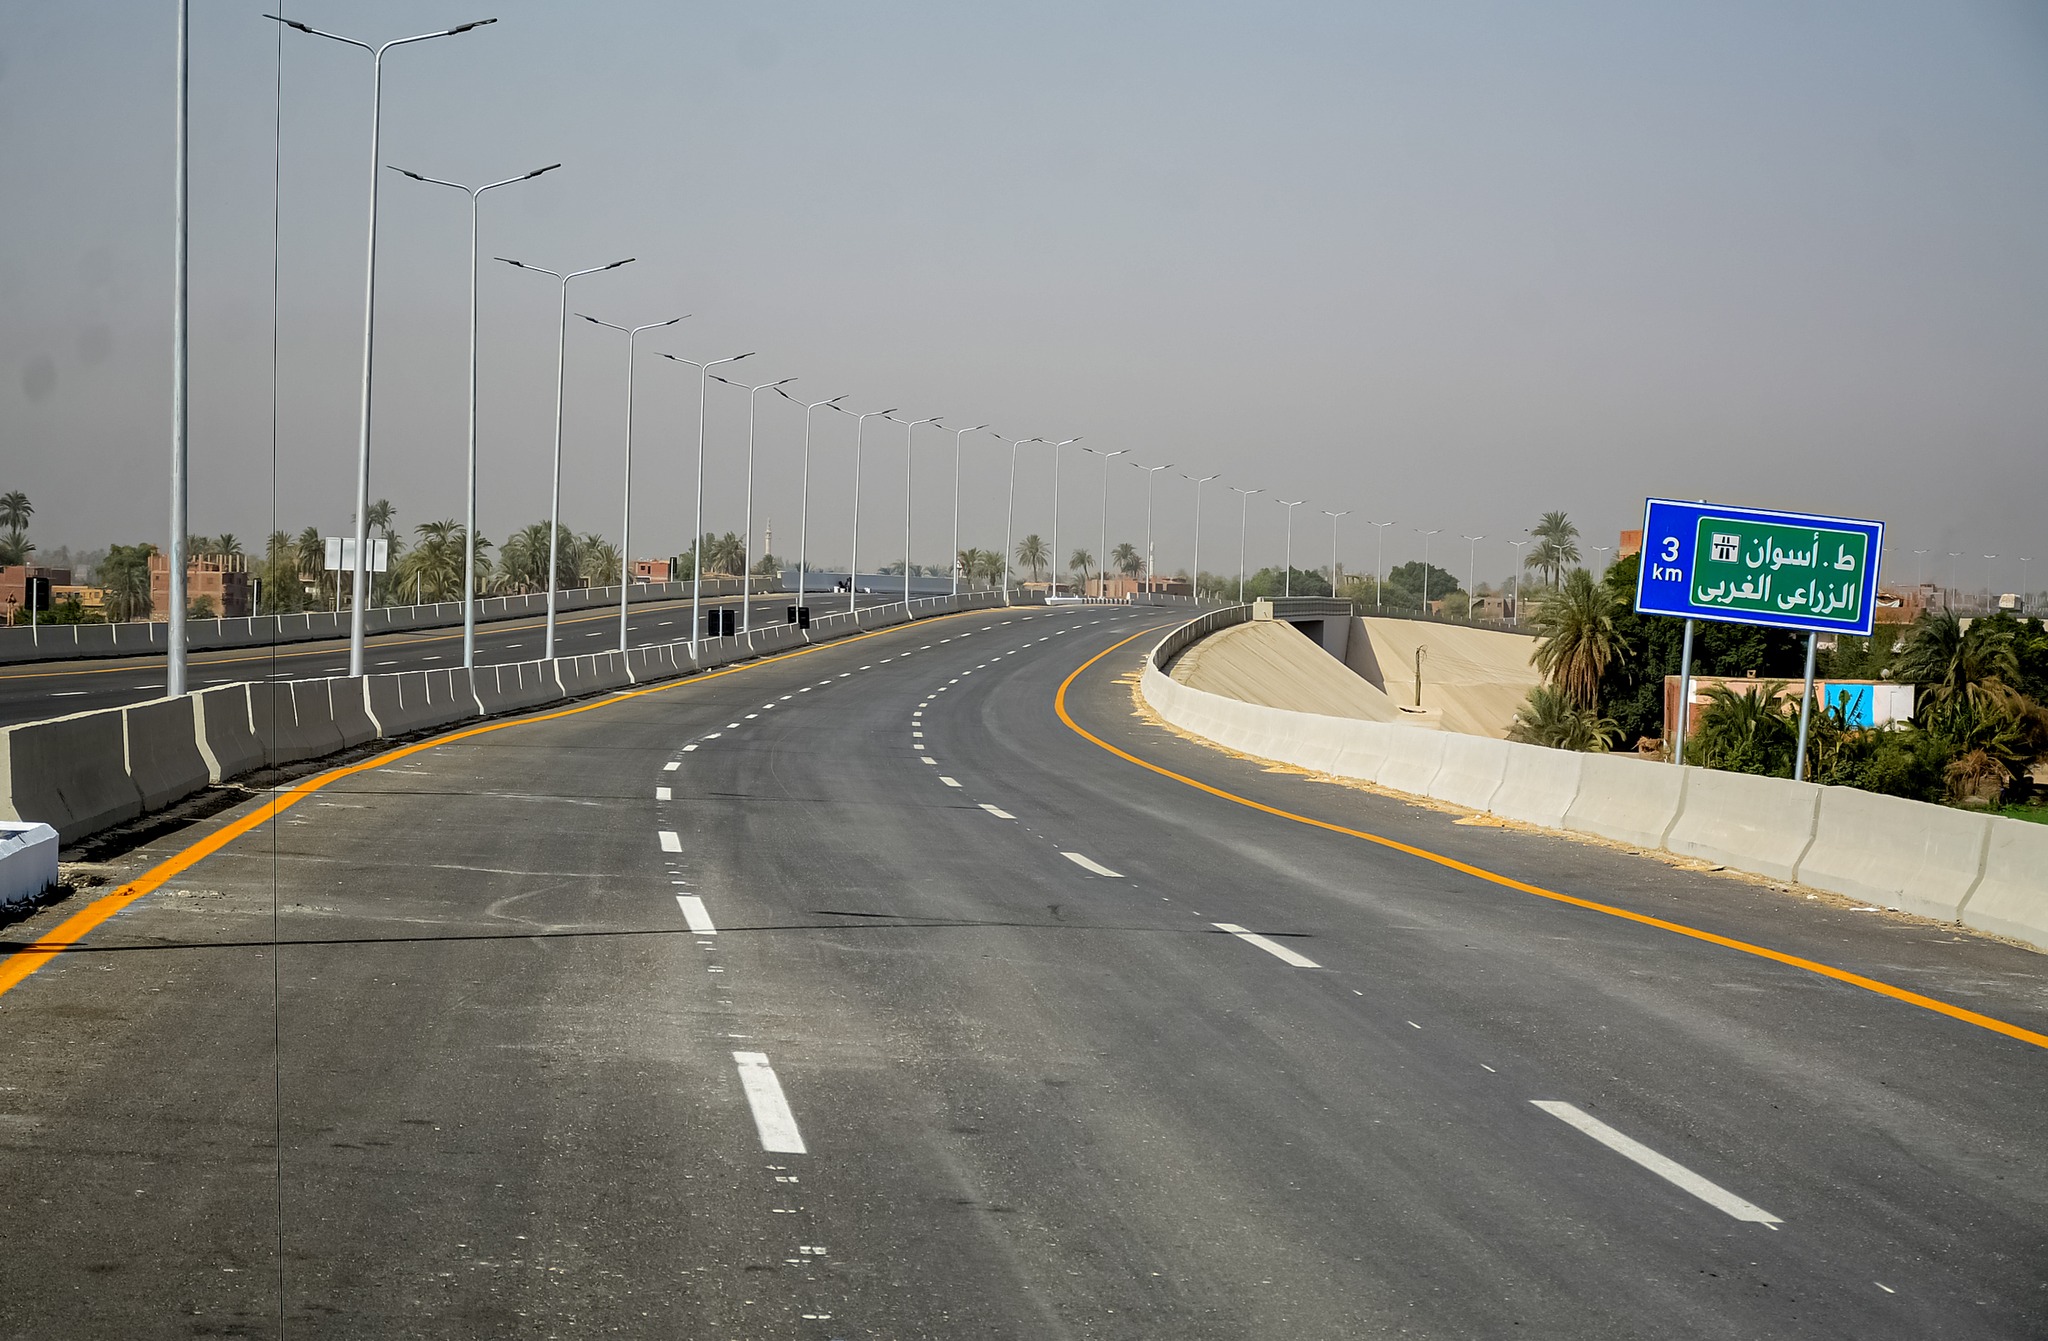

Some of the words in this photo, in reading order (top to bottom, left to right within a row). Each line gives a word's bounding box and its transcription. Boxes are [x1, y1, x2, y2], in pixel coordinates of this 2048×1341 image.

[1661, 537, 1680, 562] 3
[1745, 532, 1819, 570] أسوان
[1652, 563, 1682, 582] km
